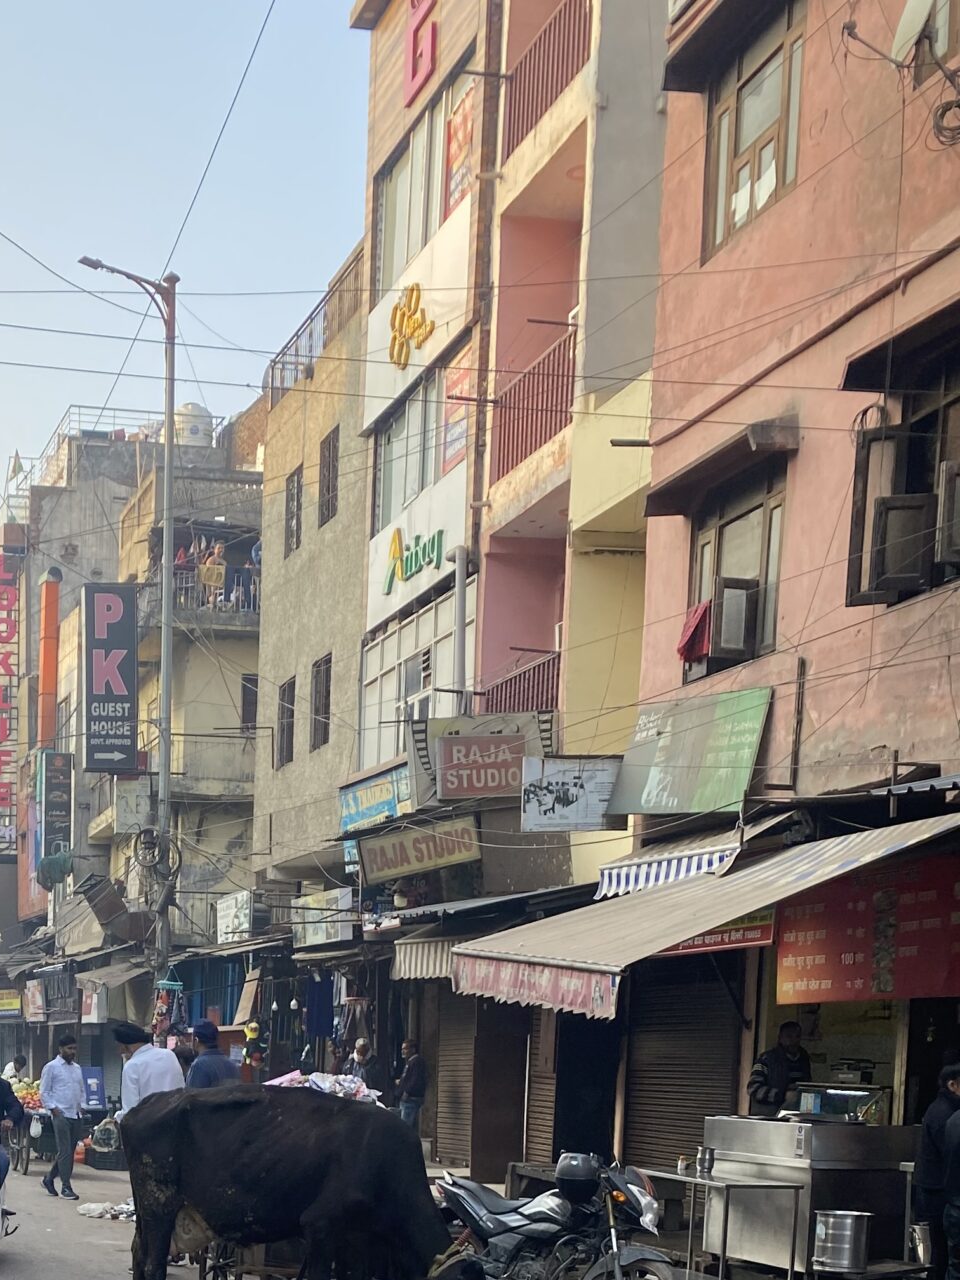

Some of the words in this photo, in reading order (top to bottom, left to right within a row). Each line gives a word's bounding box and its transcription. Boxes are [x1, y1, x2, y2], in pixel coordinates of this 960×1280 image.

[90, 702, 131, 717] GUEST
[90, 721, 131, 735] HOUSE
[106, 738, 131, 746] APPROVED
[452, 744, 512, 764] RAJA
[447, 767, 520, 789] STUDIO
[367, 841, 412, 873] RAJA
[412, 827, 474, 863] STUDIO
